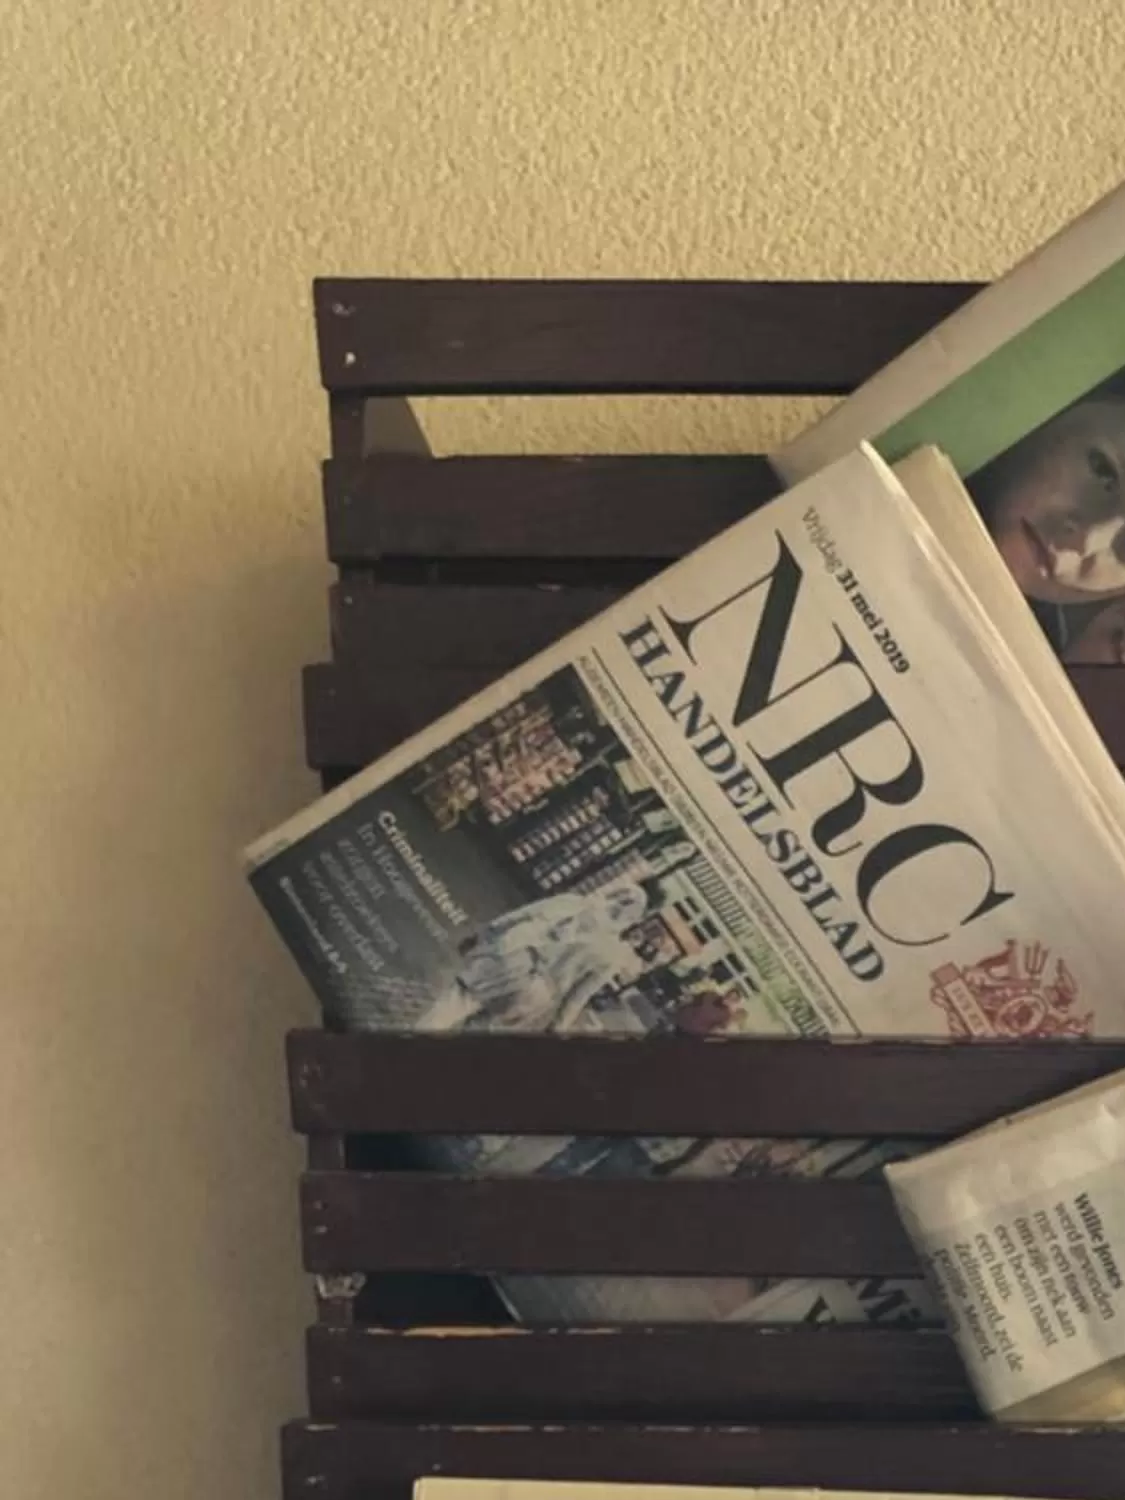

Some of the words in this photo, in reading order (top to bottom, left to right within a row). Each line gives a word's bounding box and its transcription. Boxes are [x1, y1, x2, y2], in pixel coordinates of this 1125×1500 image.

[834, 566, 861, 594] 31
[849, 588, 885, 630] mei
[871, 626, 912, 676] 2019
[616, 612, 891, 989] HANDELSBLAD
[655, 528, 1015, 969] NRC
[378, 810, 467, 924] Criminaliteit
[1074, 1193, 1104, 1242] Willie
[1092, 1244, 1124, 1289] Jones
